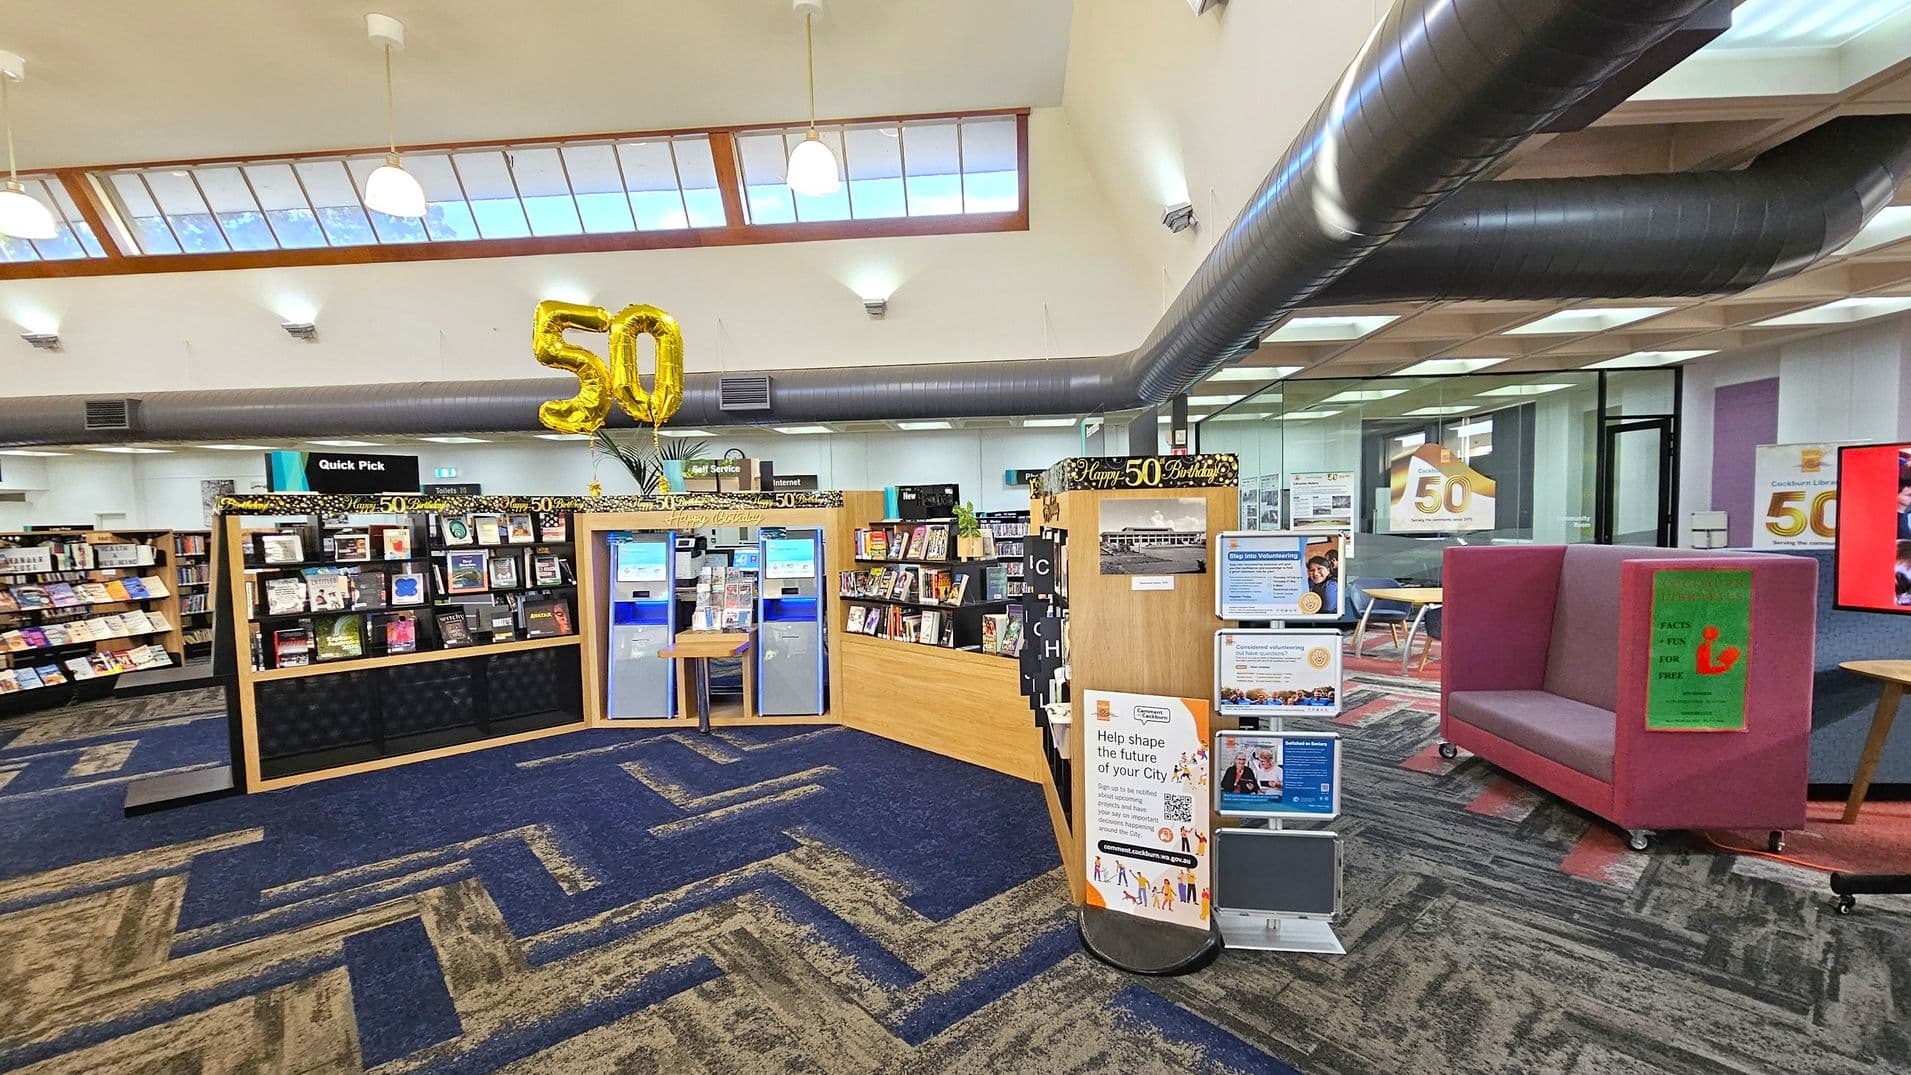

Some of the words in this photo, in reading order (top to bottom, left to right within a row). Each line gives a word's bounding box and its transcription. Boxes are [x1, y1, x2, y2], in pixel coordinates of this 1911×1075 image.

[533, 300, 684, 434] 50
[319, 459, 354, 471] Quick
[359, 460, 385, 471] Pick
[692, 465, 708, 474] Self
[710, 464, 741, 473] Service
[1076, 459, 1125, 488] Happy
[1161, 459, 1219, 484] Birthday!
[773, 478, 801, 486] Internet
[903, 492, 916, 500] New
[1415, 475, 1472, 513] 50
[342, 495, 377, 514] Happy
[664, 509, 709, 528] Happy
[713, 509, 765, 526] Birthday
[1660, 621, 1691, 629] FACTS
[1045, 640, 1060, 658] H
[1667, 637, 1686, 645] FUN
[1659, 655, 1680, 663] FOR
[1658, 672, 1684, 680] FREE
[1098, 730, 1125, 744] Help
[1128, 734, 1165, 749] shape
[1098, 746, 1117, 758] the
[1120, 748, 1157, 763] future
[1098, 762, 1109, 774] of
[1113, 766, 1139, 777] your
[1144, 767, 1168, 783] City
